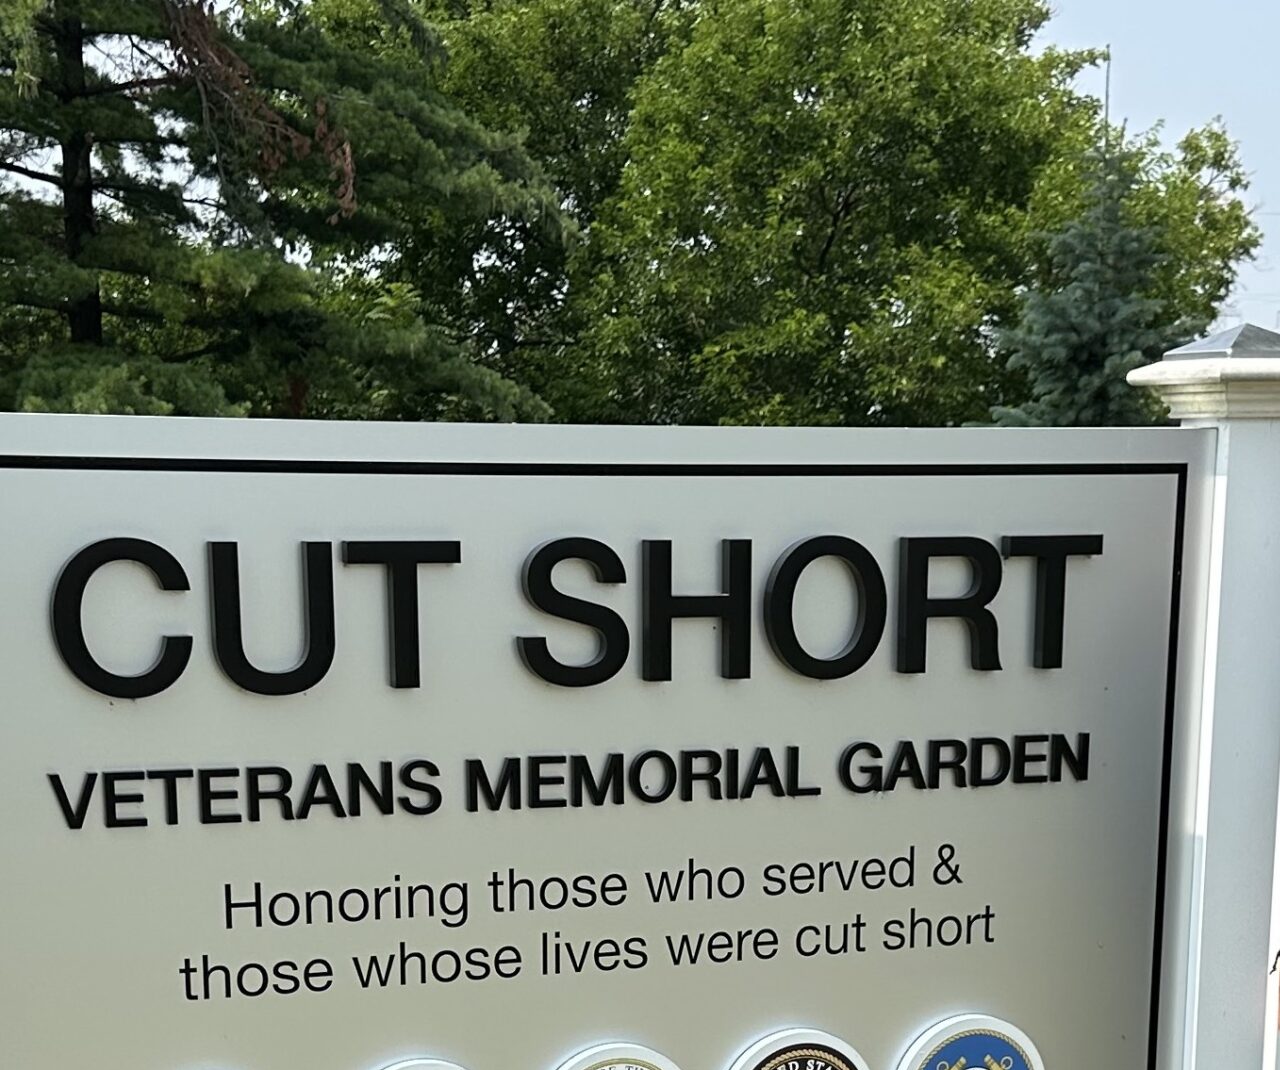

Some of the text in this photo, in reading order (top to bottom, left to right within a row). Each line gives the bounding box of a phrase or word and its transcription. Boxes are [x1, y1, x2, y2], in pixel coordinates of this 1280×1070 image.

[50, 533, 1104, 700] CUT SHORT
[47, 732, 1091, 830] VETERANS MEMORIAL GARDEN
[224, 843, 963, 929] Honoring those who served &
[179, 905, 995, 1001] those whose lives were cut short
